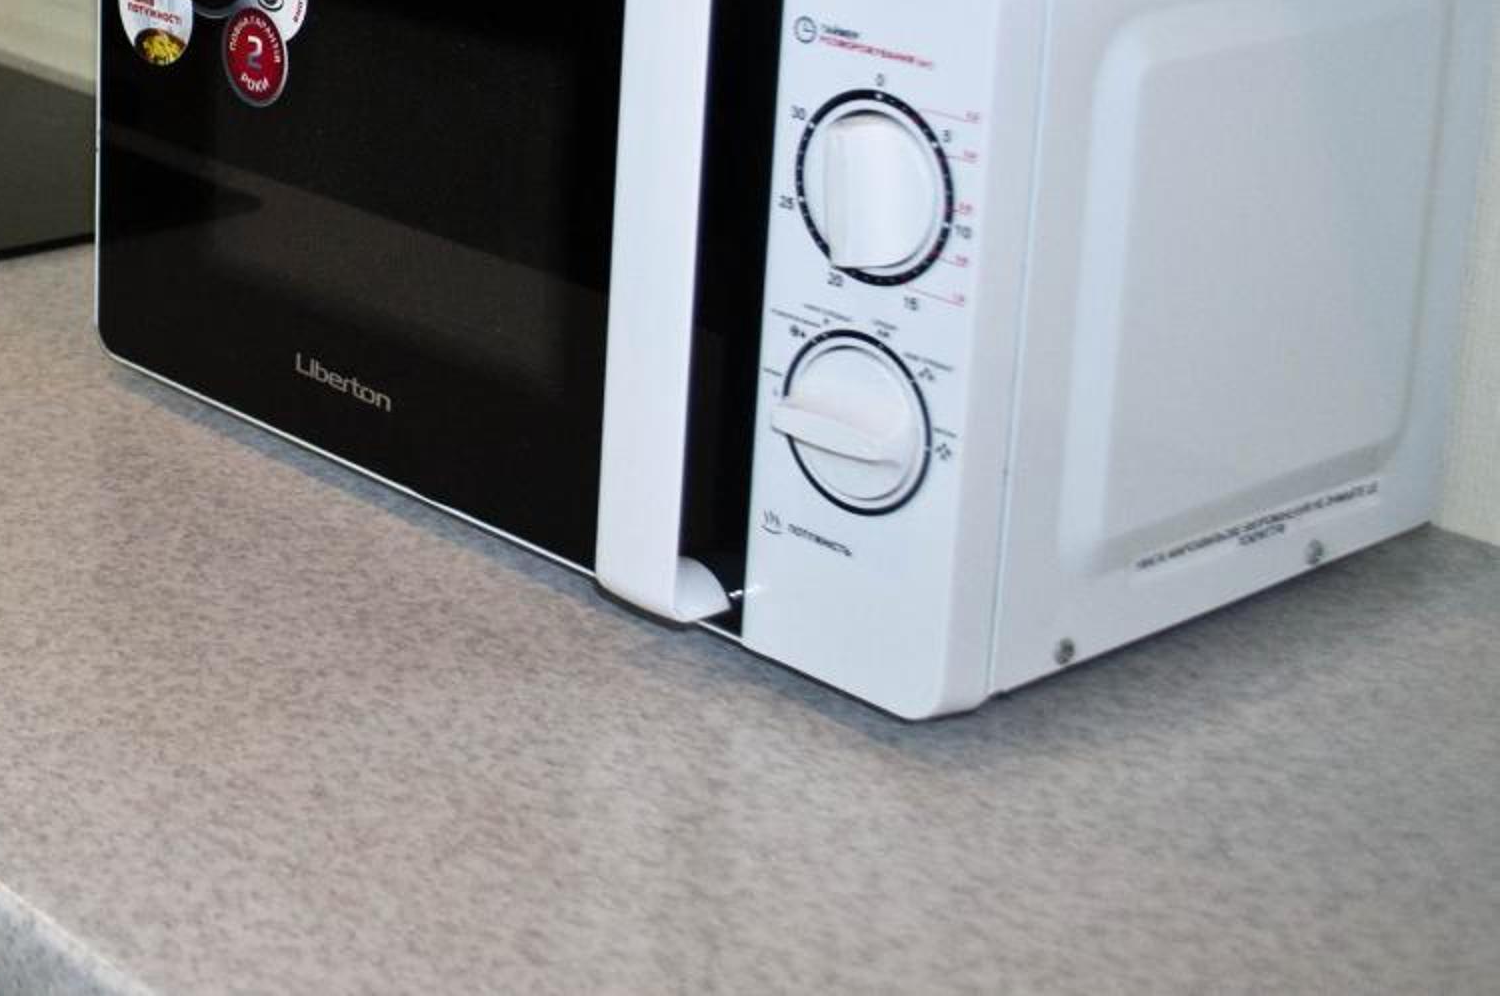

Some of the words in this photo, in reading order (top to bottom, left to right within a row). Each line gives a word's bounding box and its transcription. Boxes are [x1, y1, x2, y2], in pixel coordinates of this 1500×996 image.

[247, 35, 263, 71] 2
[241, 72, 270, 93] РОКИ
[295, 351, 392, 413] Liberton
